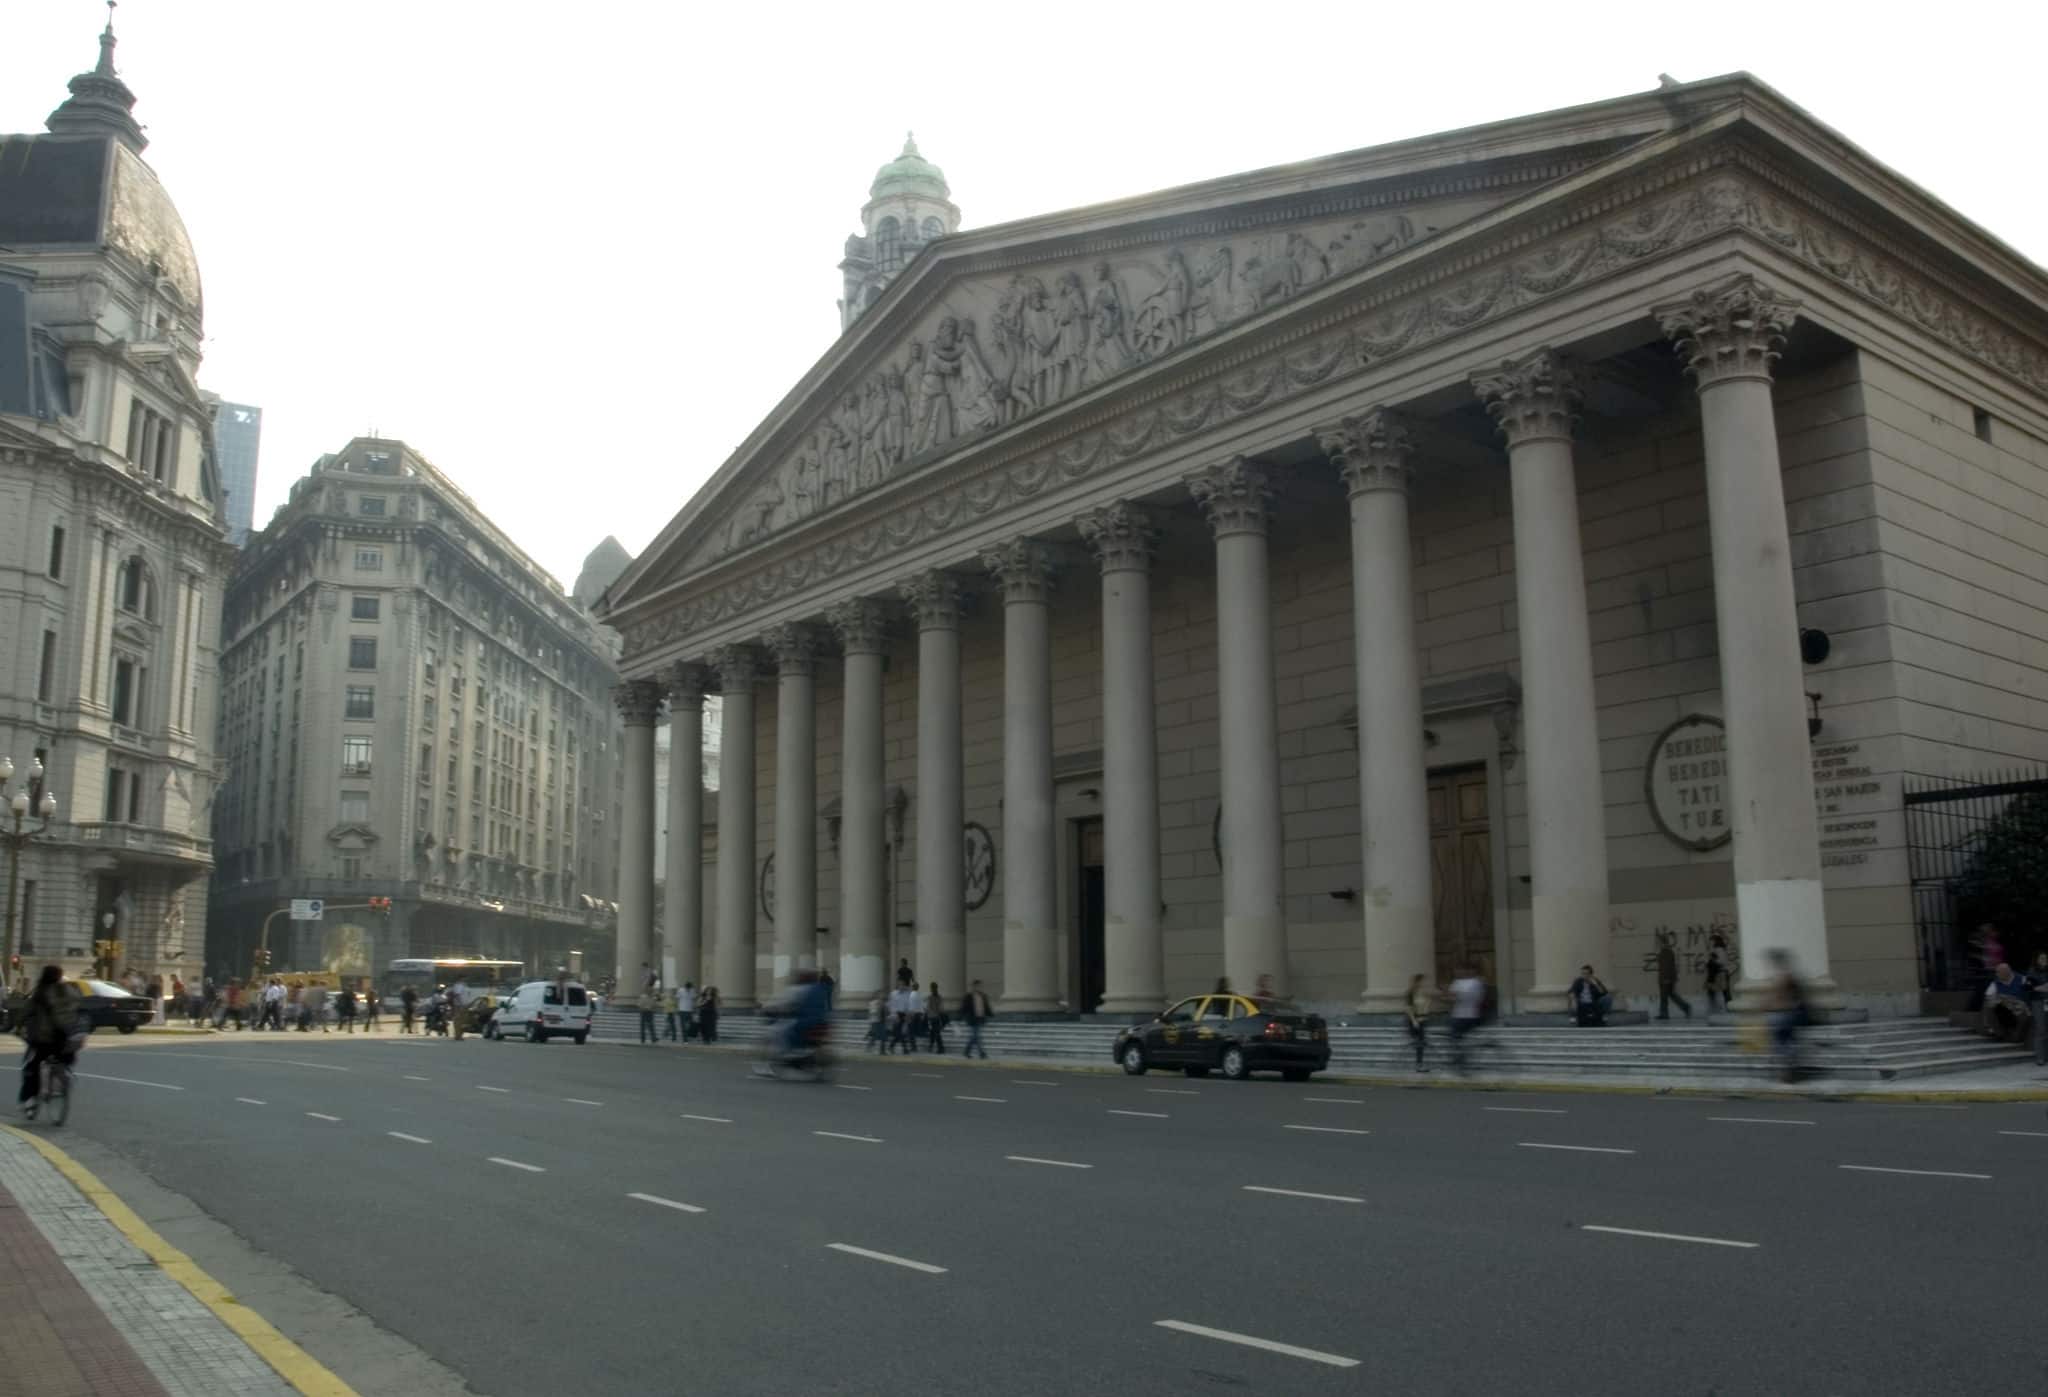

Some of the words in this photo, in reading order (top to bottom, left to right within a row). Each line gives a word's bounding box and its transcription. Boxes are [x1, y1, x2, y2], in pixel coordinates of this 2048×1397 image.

[1676, 784, 1721, 806] TATI
[1823, 786, 1843, 798] SAN
[1846, 782, 1881, 795] MARTIN
